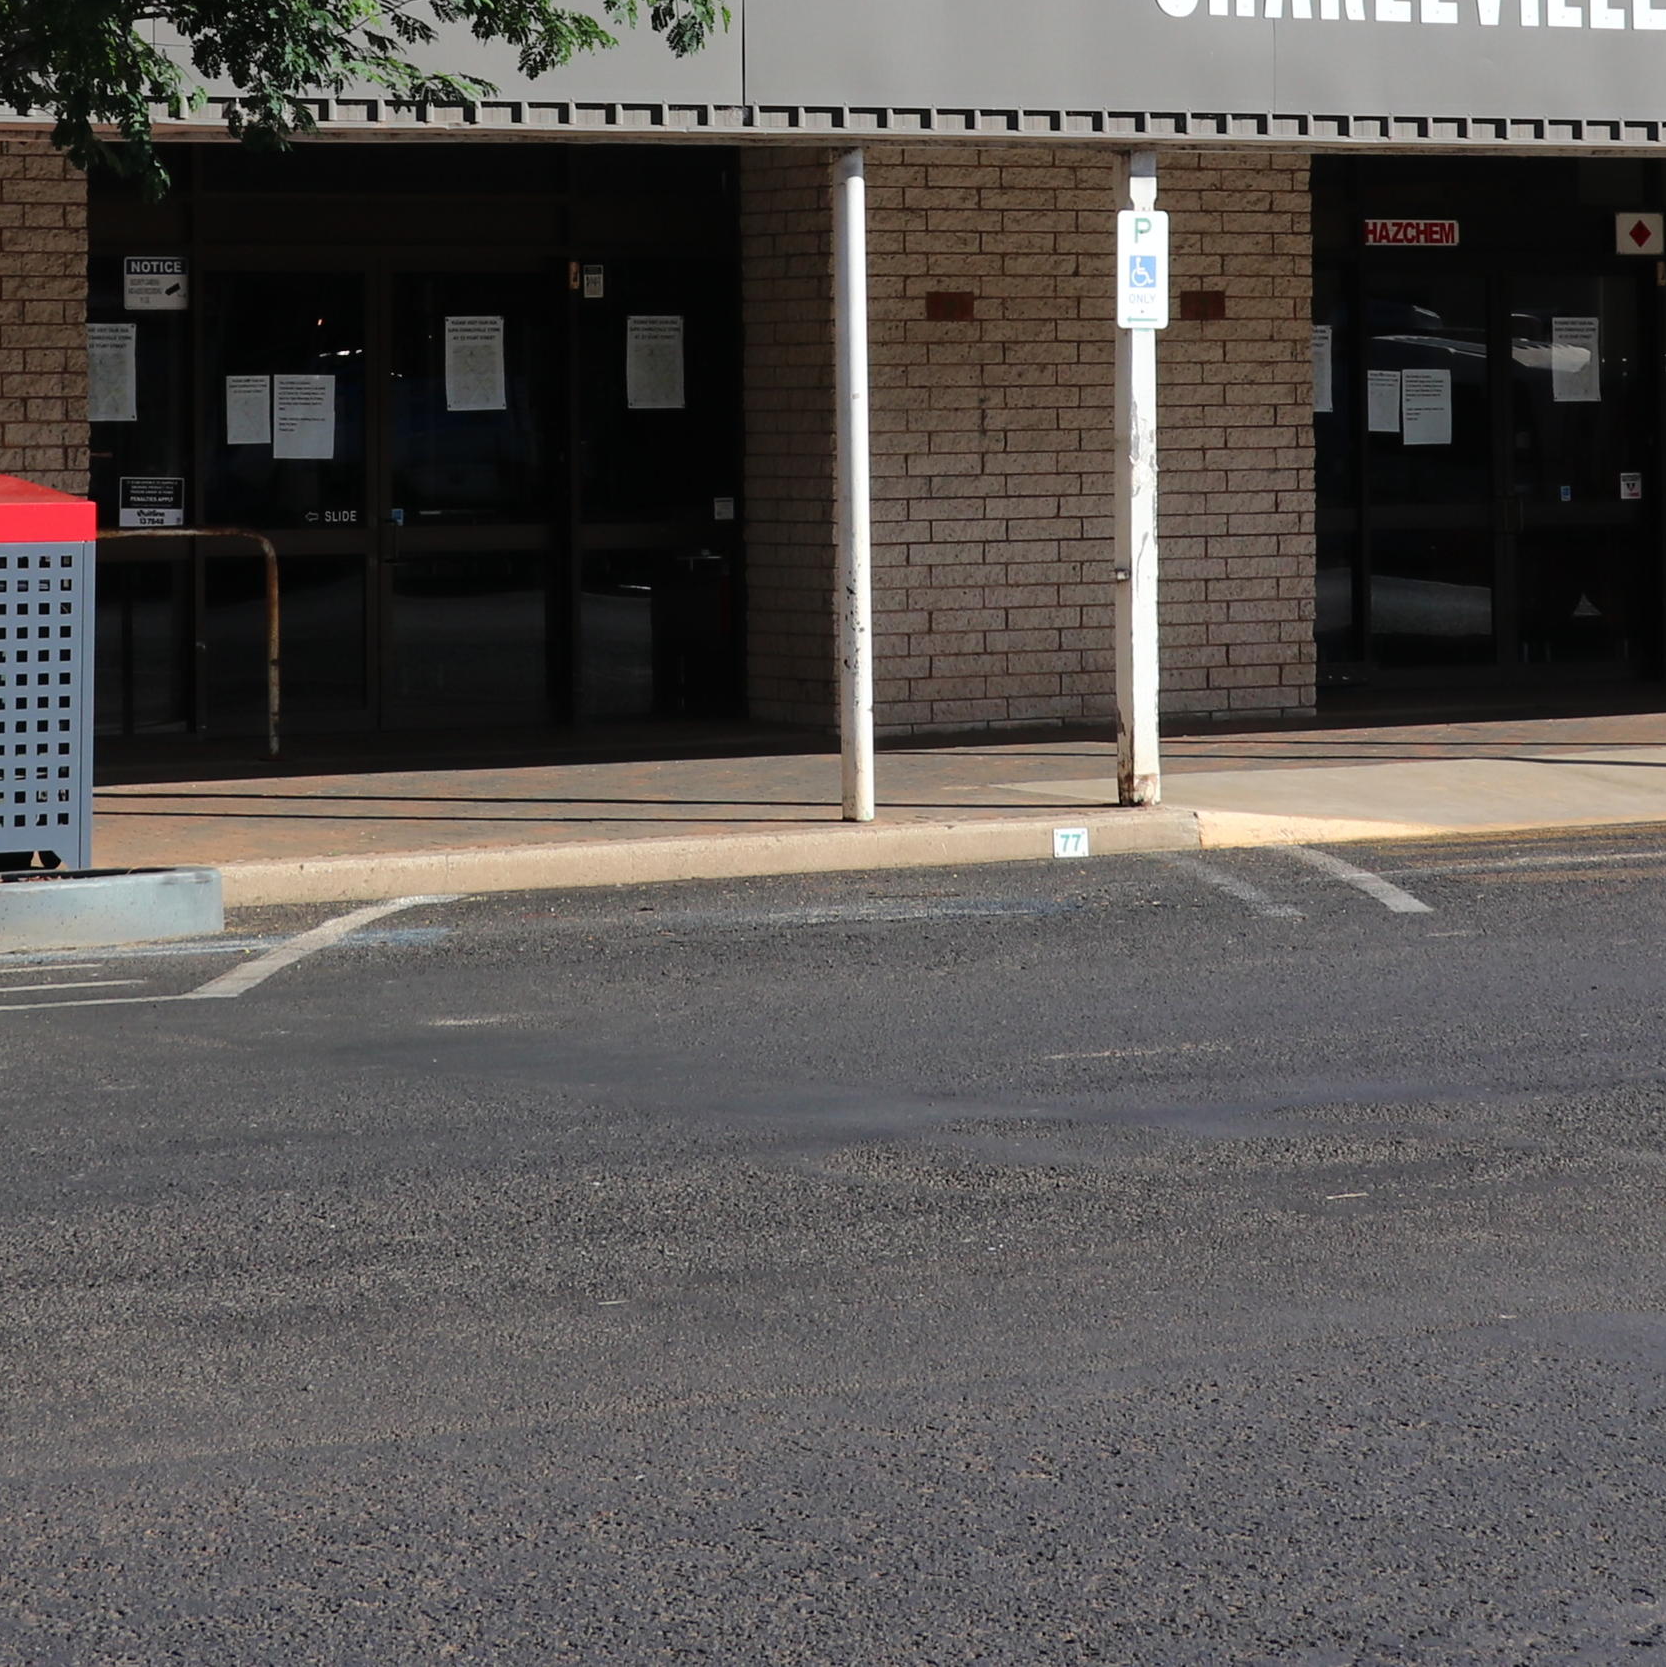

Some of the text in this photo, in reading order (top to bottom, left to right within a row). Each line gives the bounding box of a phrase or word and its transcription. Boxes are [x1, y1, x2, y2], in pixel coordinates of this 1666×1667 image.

[1134, 218, 1152, 244] P
[1365, 221, 1455, 244] HAZCHEM
[130, 261, 182, 273] NOTICE
[1129, 293, 1157, 304] ONLY
[324, 510, 357, 522] SLIDE
[1060, 834, 1082, 853] 77
